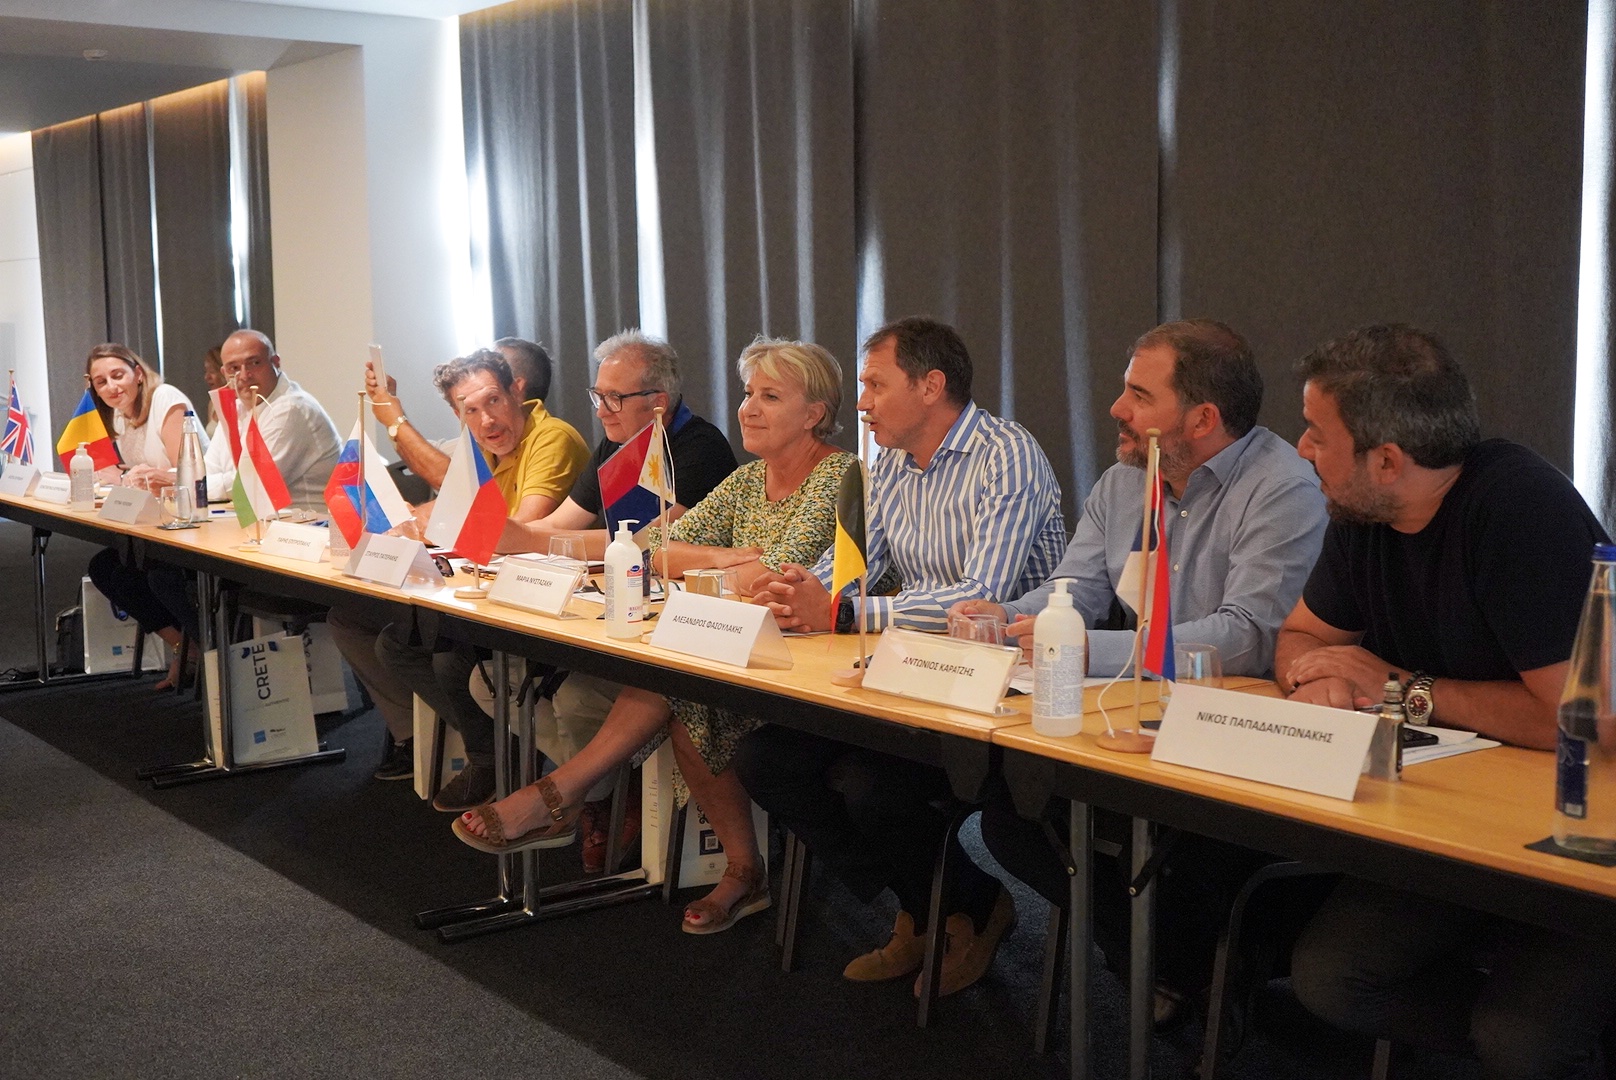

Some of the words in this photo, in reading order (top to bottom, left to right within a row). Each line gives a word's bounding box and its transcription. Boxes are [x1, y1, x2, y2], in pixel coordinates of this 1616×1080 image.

[672, 615, 706, 628] ΑΛΕΞΑΝΔΡΟΣ
[705, 621, 743, 635] ΦΑΣΟΥΛΑΚΗΣ
[251, 643, 271, 700] CRETE
[902, 656, 939, 670] ΑΝΤΩΝΙΟΣ
[939, 664, 975, 677] ΚΑΡΑΤΖΗΣ
[1196, 711, 1228, 726] ΝΙΚΟΣ
[1229, 717, 1333, 744] ΠΑΠΑΔΑΝΤΩΝΑΚΗΣ
